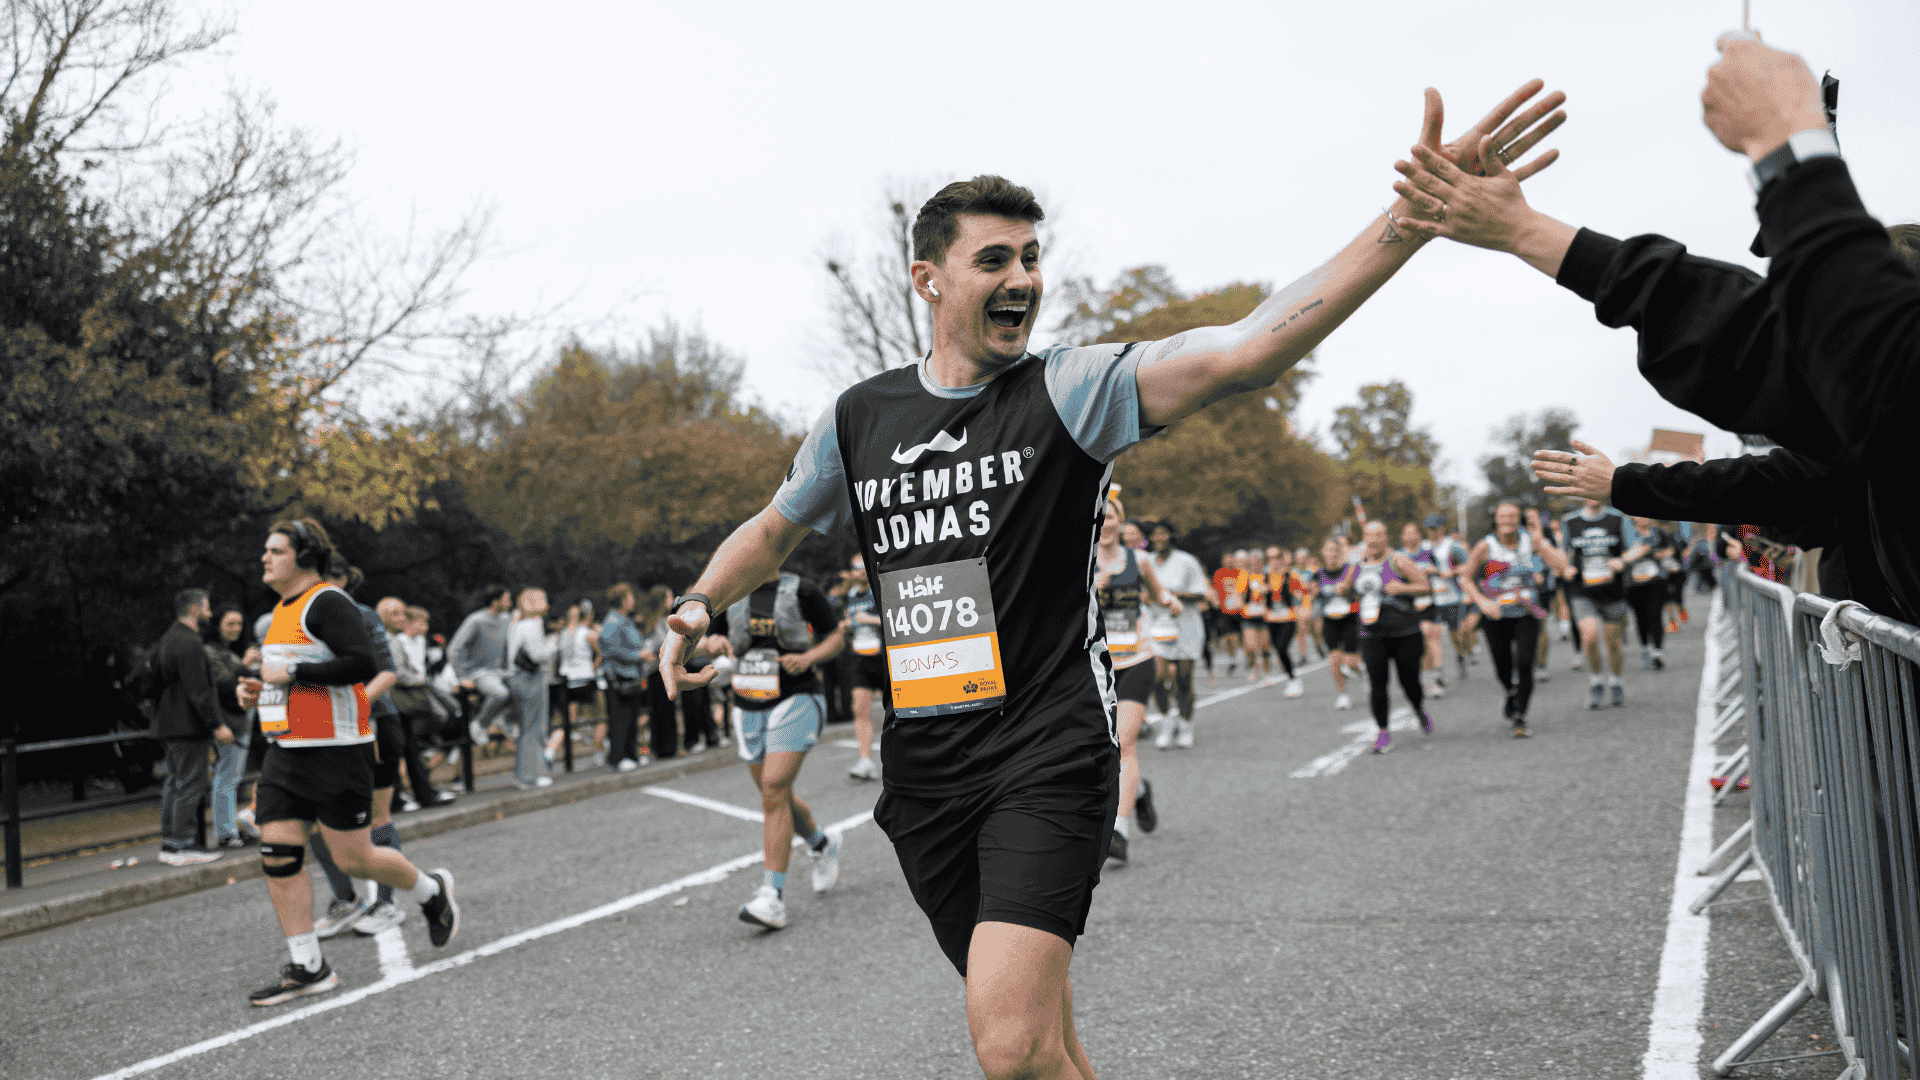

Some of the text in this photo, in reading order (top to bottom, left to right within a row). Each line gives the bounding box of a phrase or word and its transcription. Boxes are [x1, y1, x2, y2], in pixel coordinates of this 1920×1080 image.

[873, 499, 991, 555] JONAS
[898, 575, 944, 600] Half
[886, 596, 979, 638] 14078
[900, 651, 959, 674] JONAS
